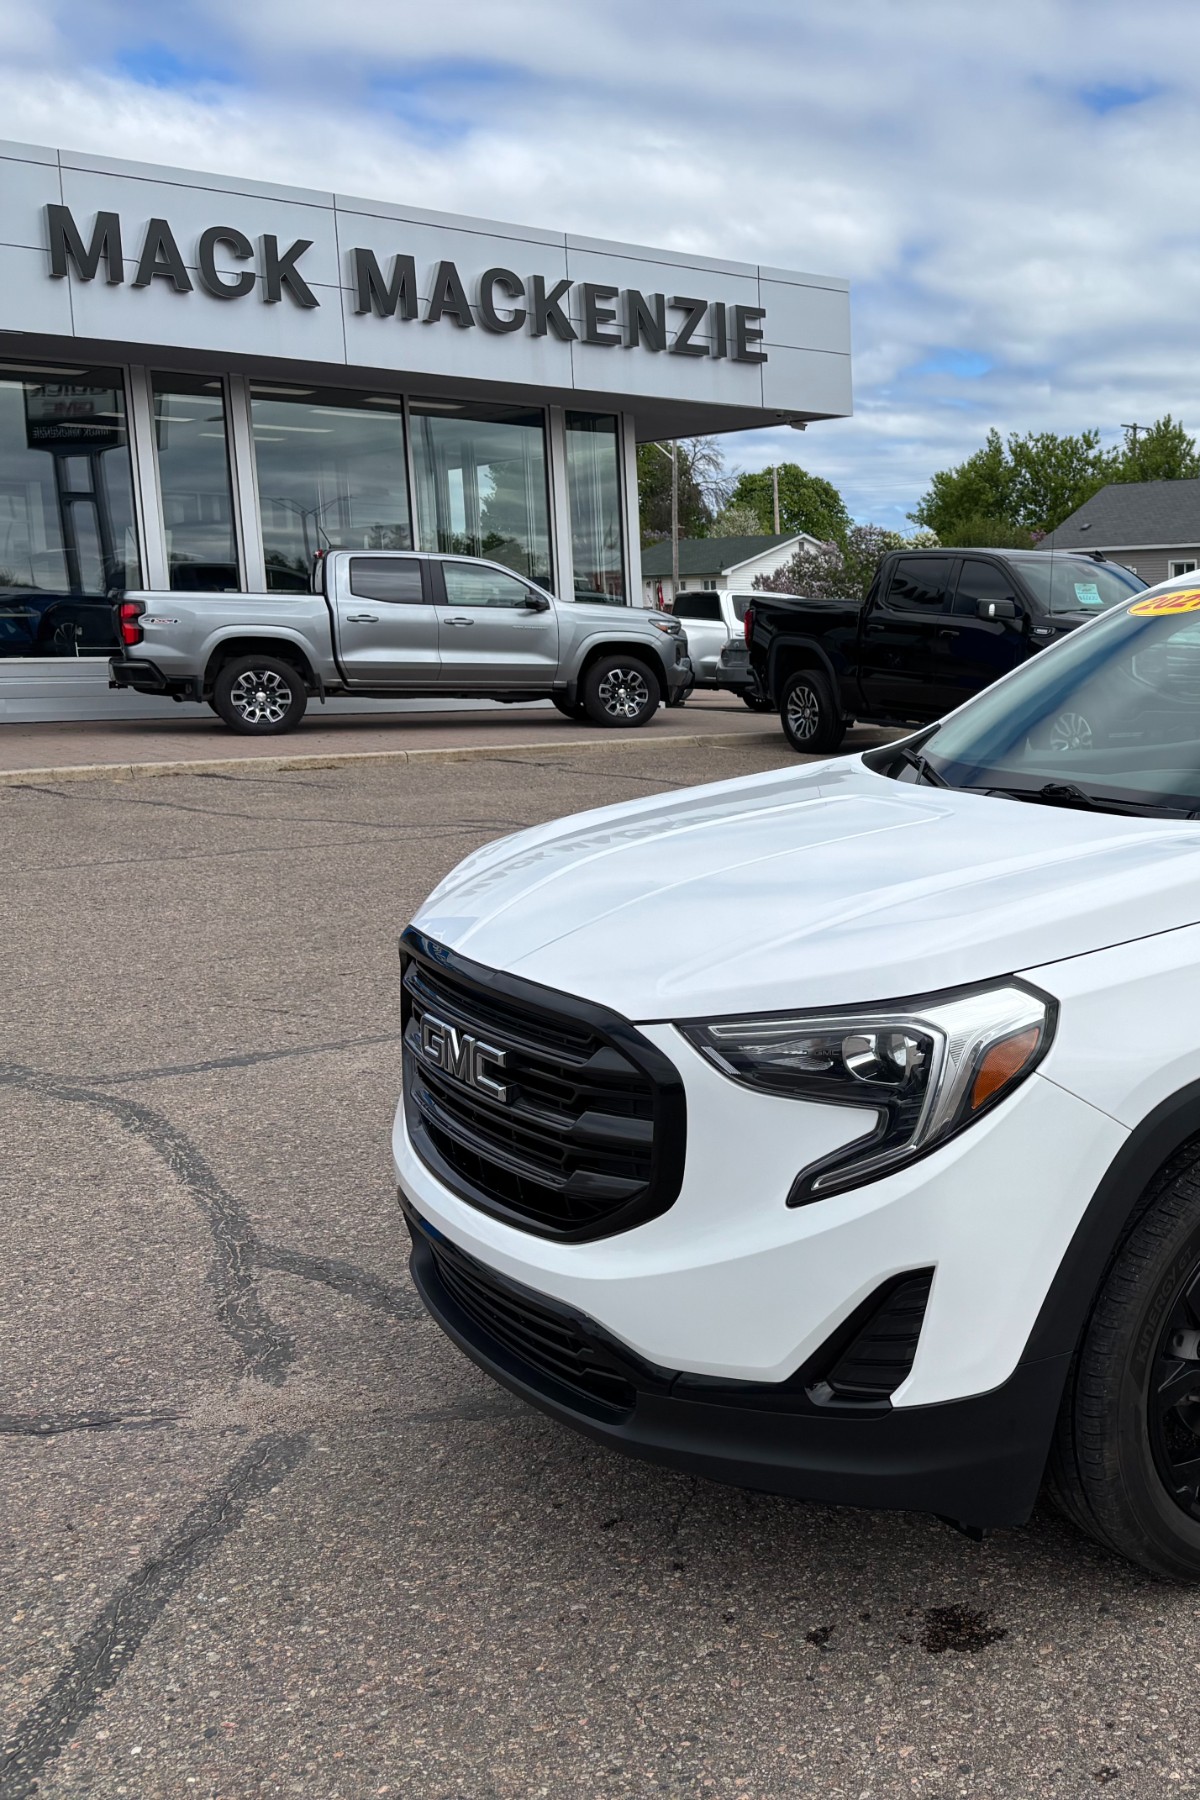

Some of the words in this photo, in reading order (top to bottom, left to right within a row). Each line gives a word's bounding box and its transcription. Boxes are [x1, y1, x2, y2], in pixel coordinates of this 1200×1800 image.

[47, 203, 321, 308] MACK
[349, 247, 769, 363] MACKENZIE
[421, 1013, 507, 1102] GMC
[1136, 1265, 1175, 1364] KINERGY
[1178, 1245, 1192, 1270] GT
